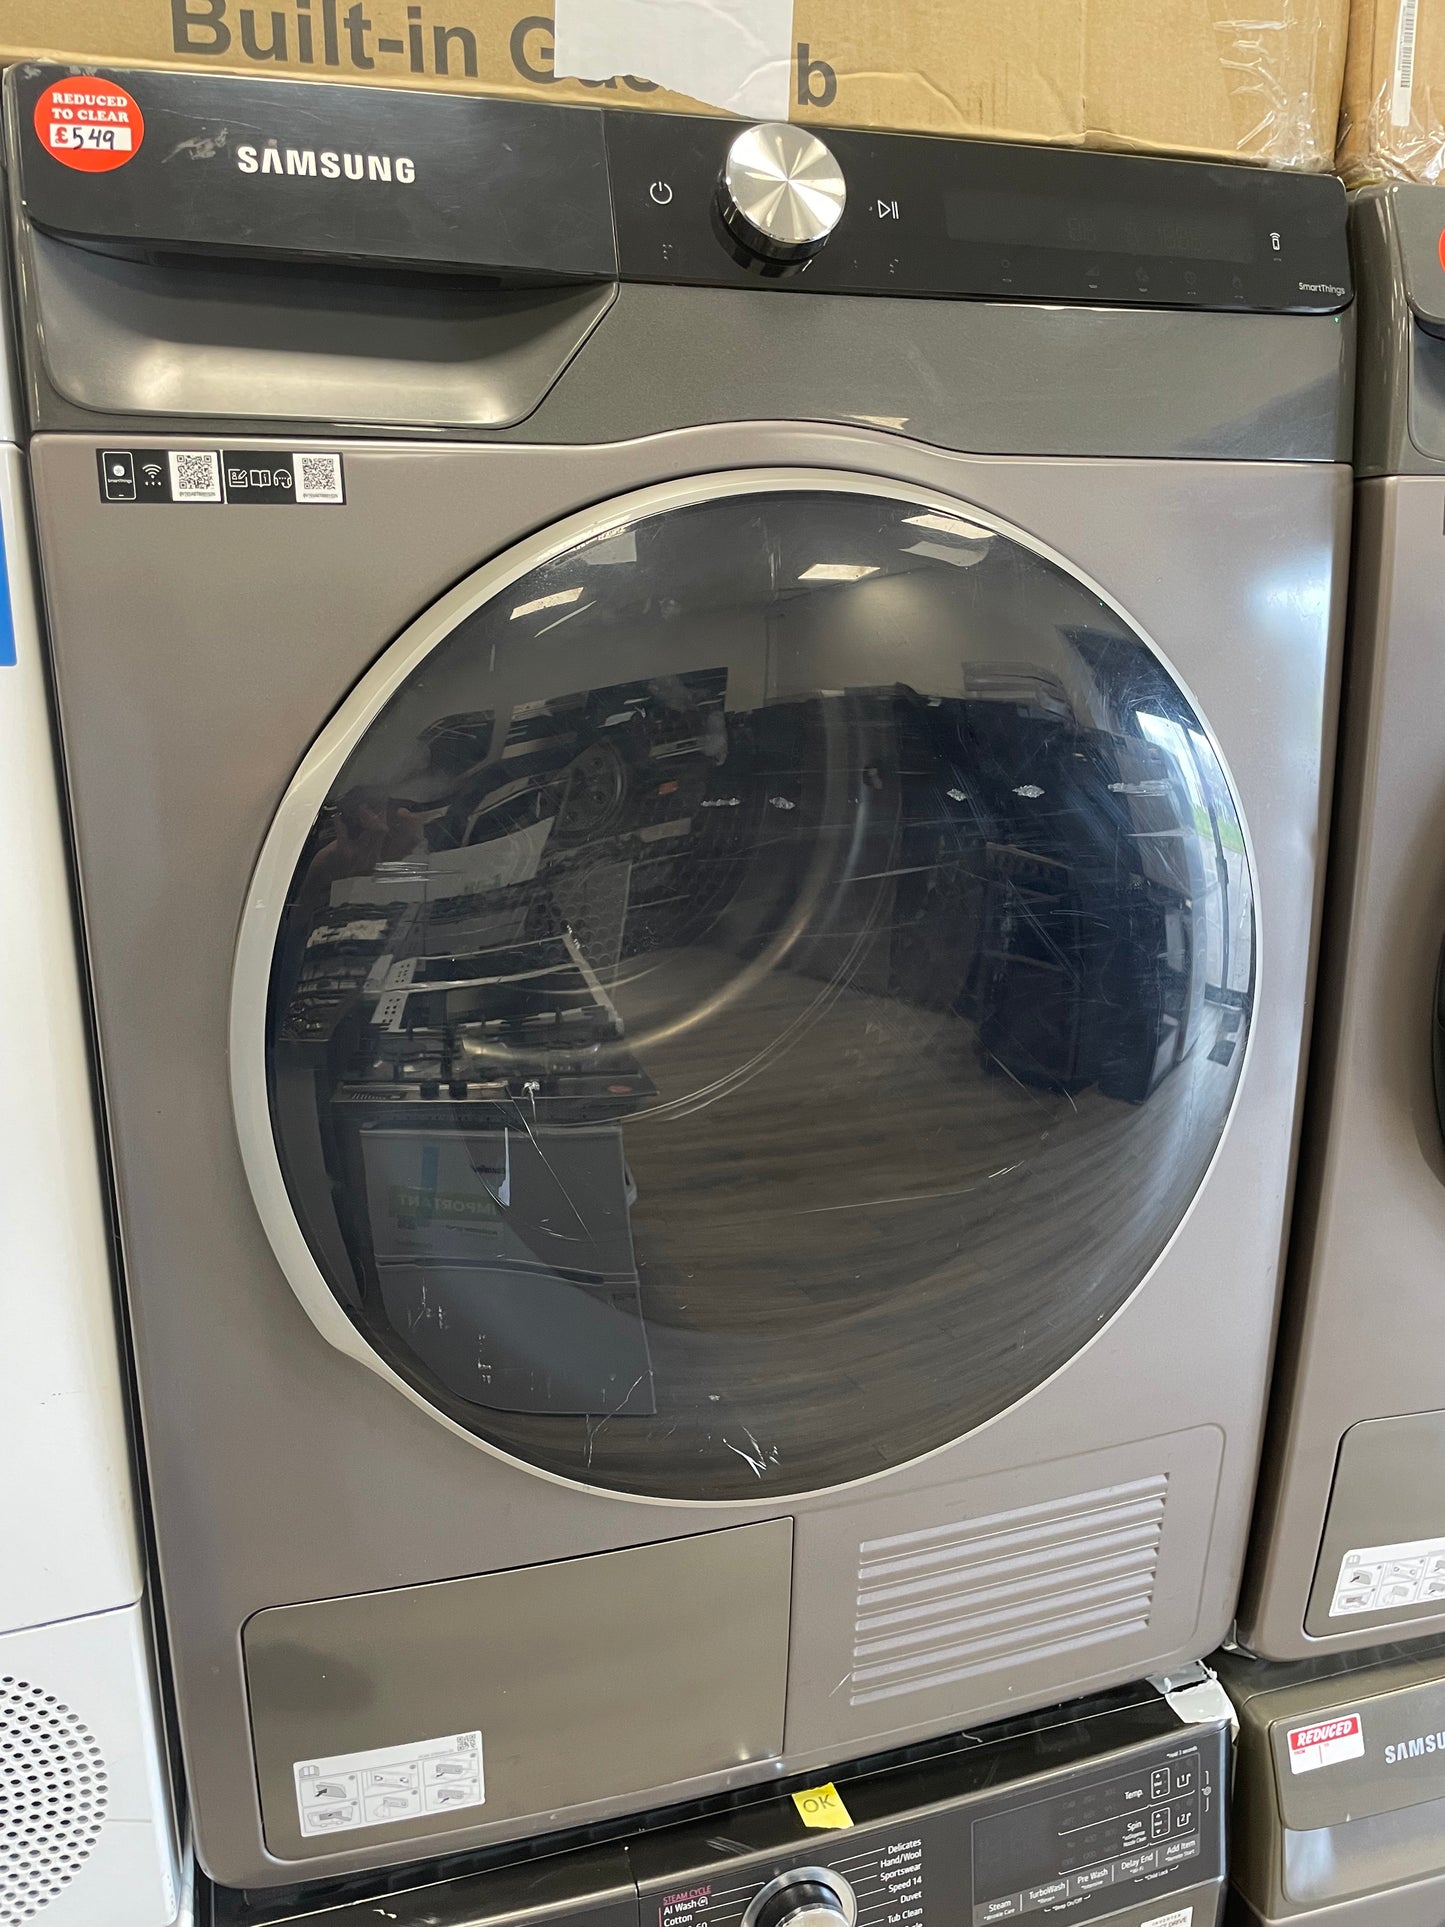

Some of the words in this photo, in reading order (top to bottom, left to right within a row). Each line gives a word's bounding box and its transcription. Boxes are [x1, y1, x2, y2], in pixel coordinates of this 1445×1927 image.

[171, 0, 478, 78] Built-in
[52, 92, 128, 107] REDUCED
[51, 108, 74, 120] TO
[77, 109, 129, 123] CLEAR
[237, 145, 416, 184] SAMSUNG
[1298, 282, 1346, 296] SmartThings
[1297, 1720, 1353, 1747] REDUCED
[803, 1793, 836, 1813] OK
[1127, 1821, 1142, 1832] Spin
[887, 1839, 922, 1854] Delicates
[1166, 1844, 1180, 1855] Add
[1180, 1840, 1196, 1851] Item
[880, 1849, 922, 1868] Hand/Wool
[1121, 1859, 1140, 1871] Delay
[1140, 1852, 1154, 1864] End
[880, 1863, 922, 1882] Sportswear
[1077, 1874, 1089, 1885] Pre
[1089, 1868, 1109, 1881] Wash
[888, 1879, 912, 1893] Speed
[912, 1875, 922, 1886] 14
[1029, 1882, 1066, 1900] TurboWash
[663, 1891, 688, 1904] STEAM
[688, 1885, 712, 1898] CYCLE
[900, 1891, 922, 1904] Duvet
[675, 1901, 697, 1914] Wash
[988, 1900, 1012, 1913] Steam
[663, 1914, 693, 1927] Cotton
[888, 1913, 901, 1924] Tub
[902, 1908, 923, 1920] Clean
